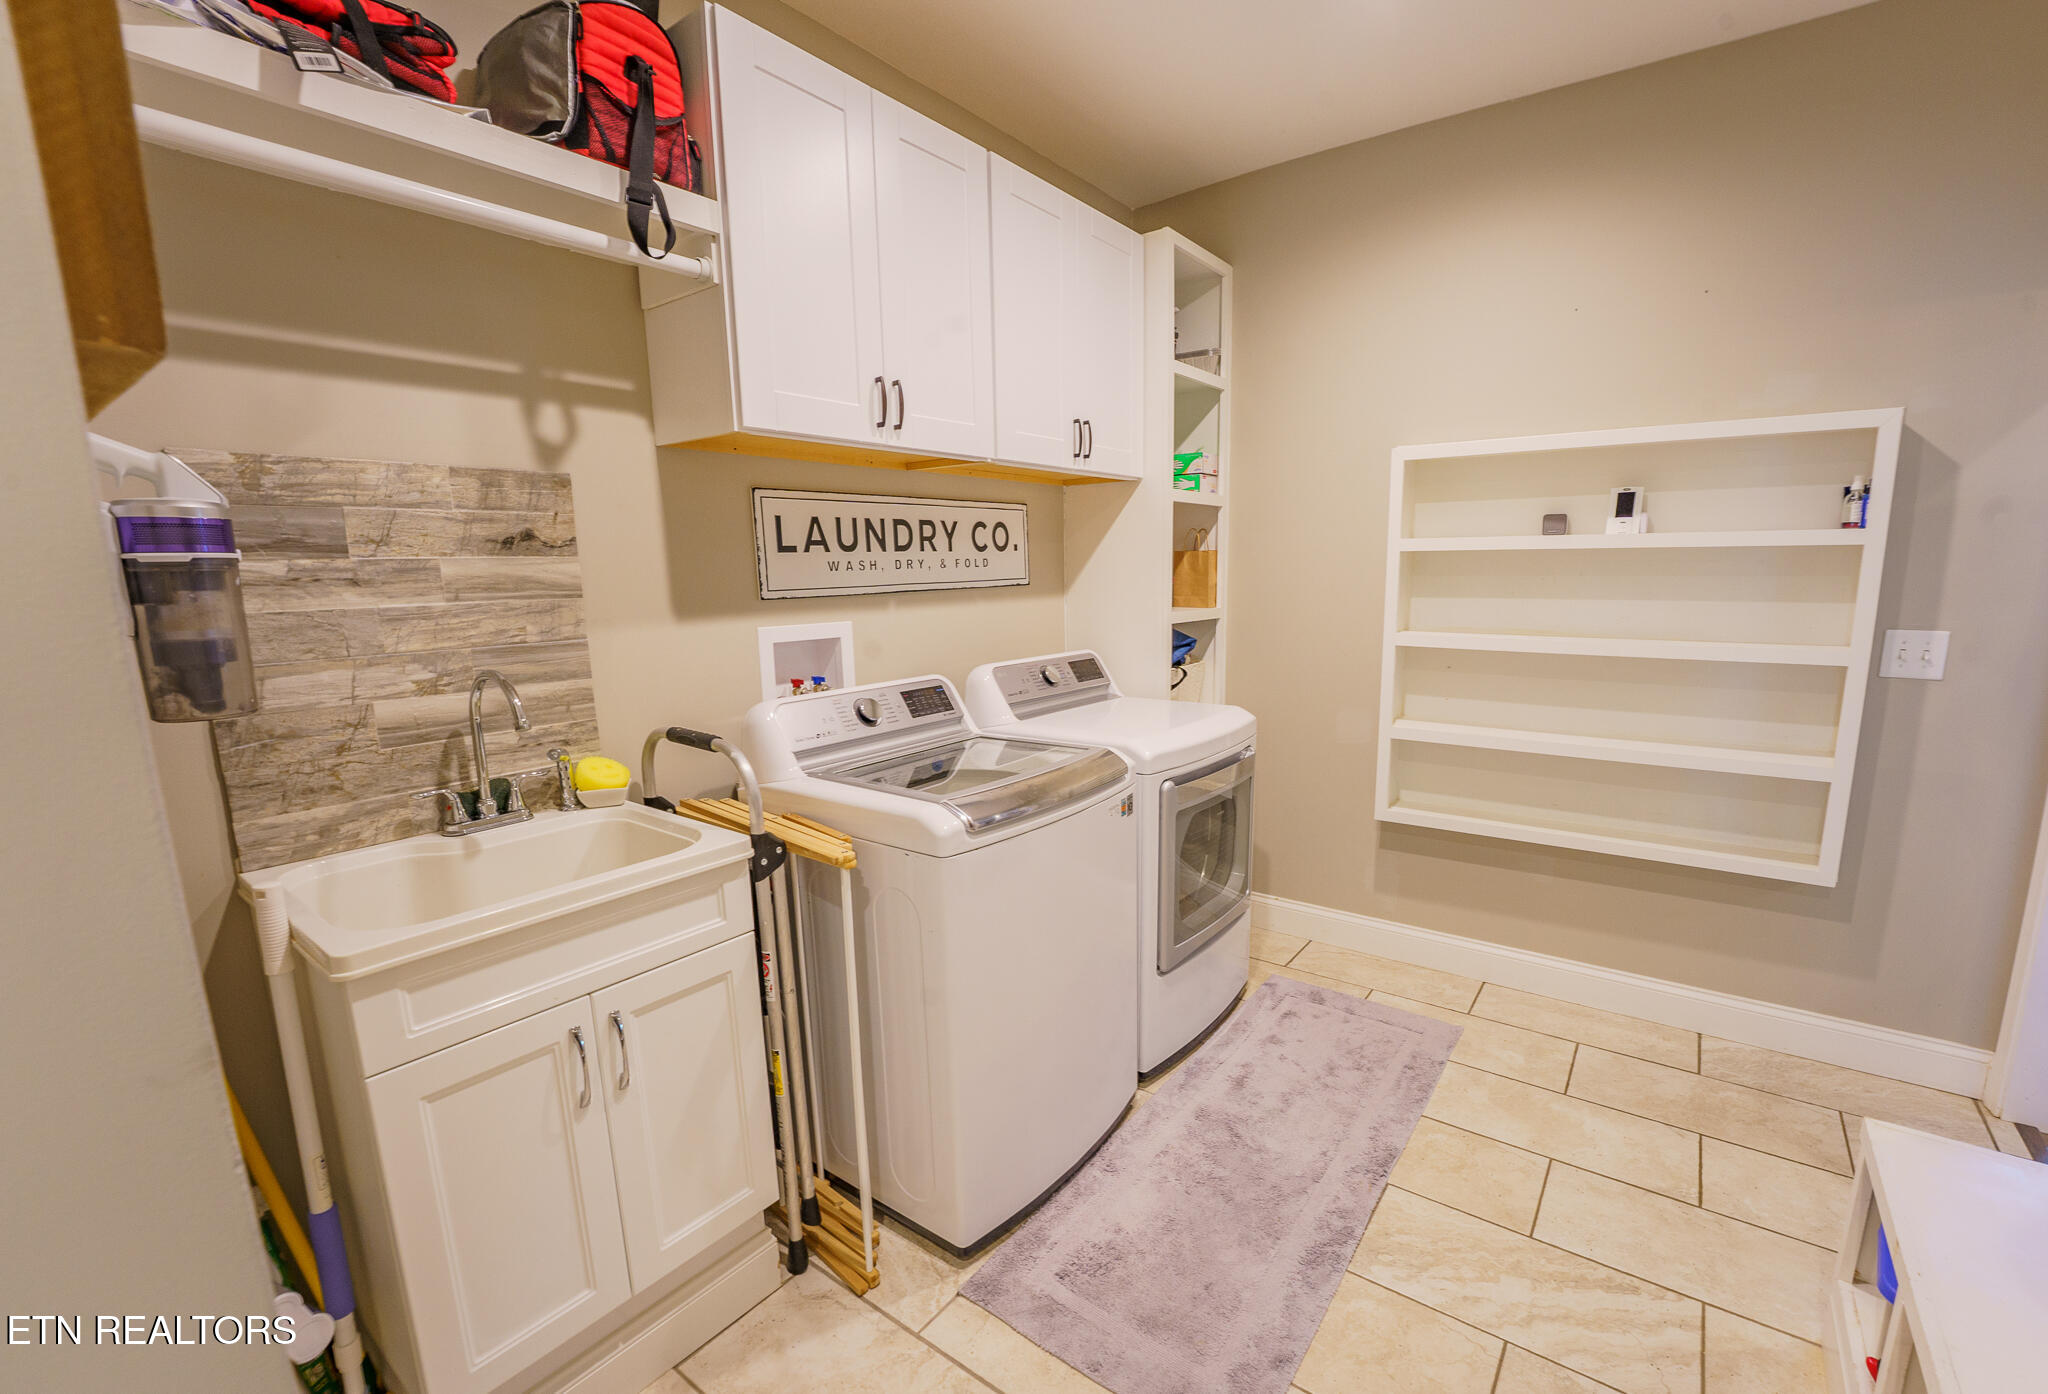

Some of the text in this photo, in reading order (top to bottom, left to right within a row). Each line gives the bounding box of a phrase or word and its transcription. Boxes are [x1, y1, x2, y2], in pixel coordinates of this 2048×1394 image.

[774, 515, 1018, 553] LAUNDRY CO.
[827, 558, 990, 572] WASH, DRY, & FOLD
